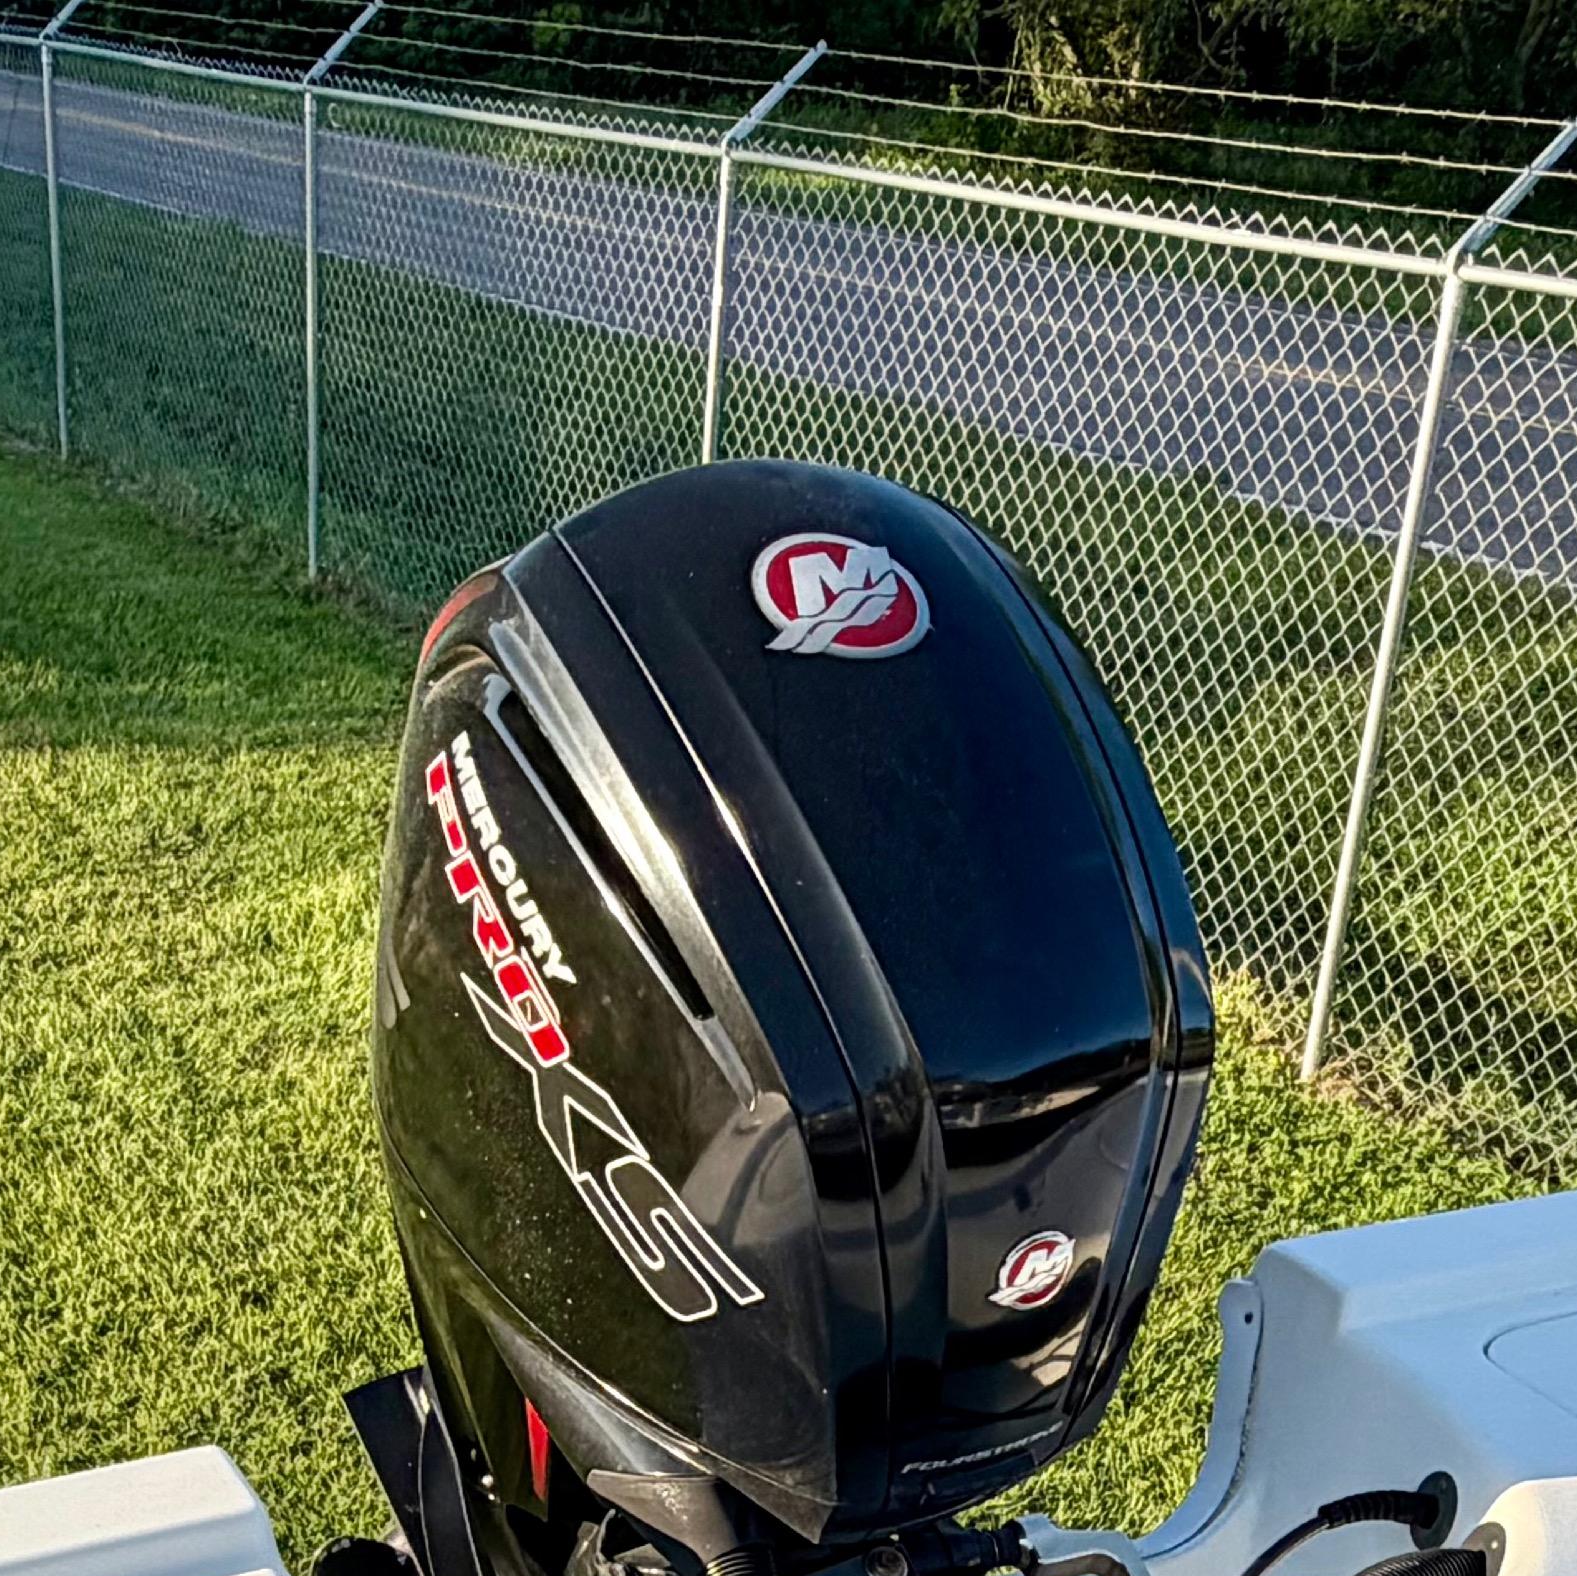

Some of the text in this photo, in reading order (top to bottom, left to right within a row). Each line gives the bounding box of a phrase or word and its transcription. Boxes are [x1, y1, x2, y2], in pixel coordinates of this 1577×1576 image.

[426, 751, 765, 1323] PRO XS
[451, 731, 577, 985] MERCURY
